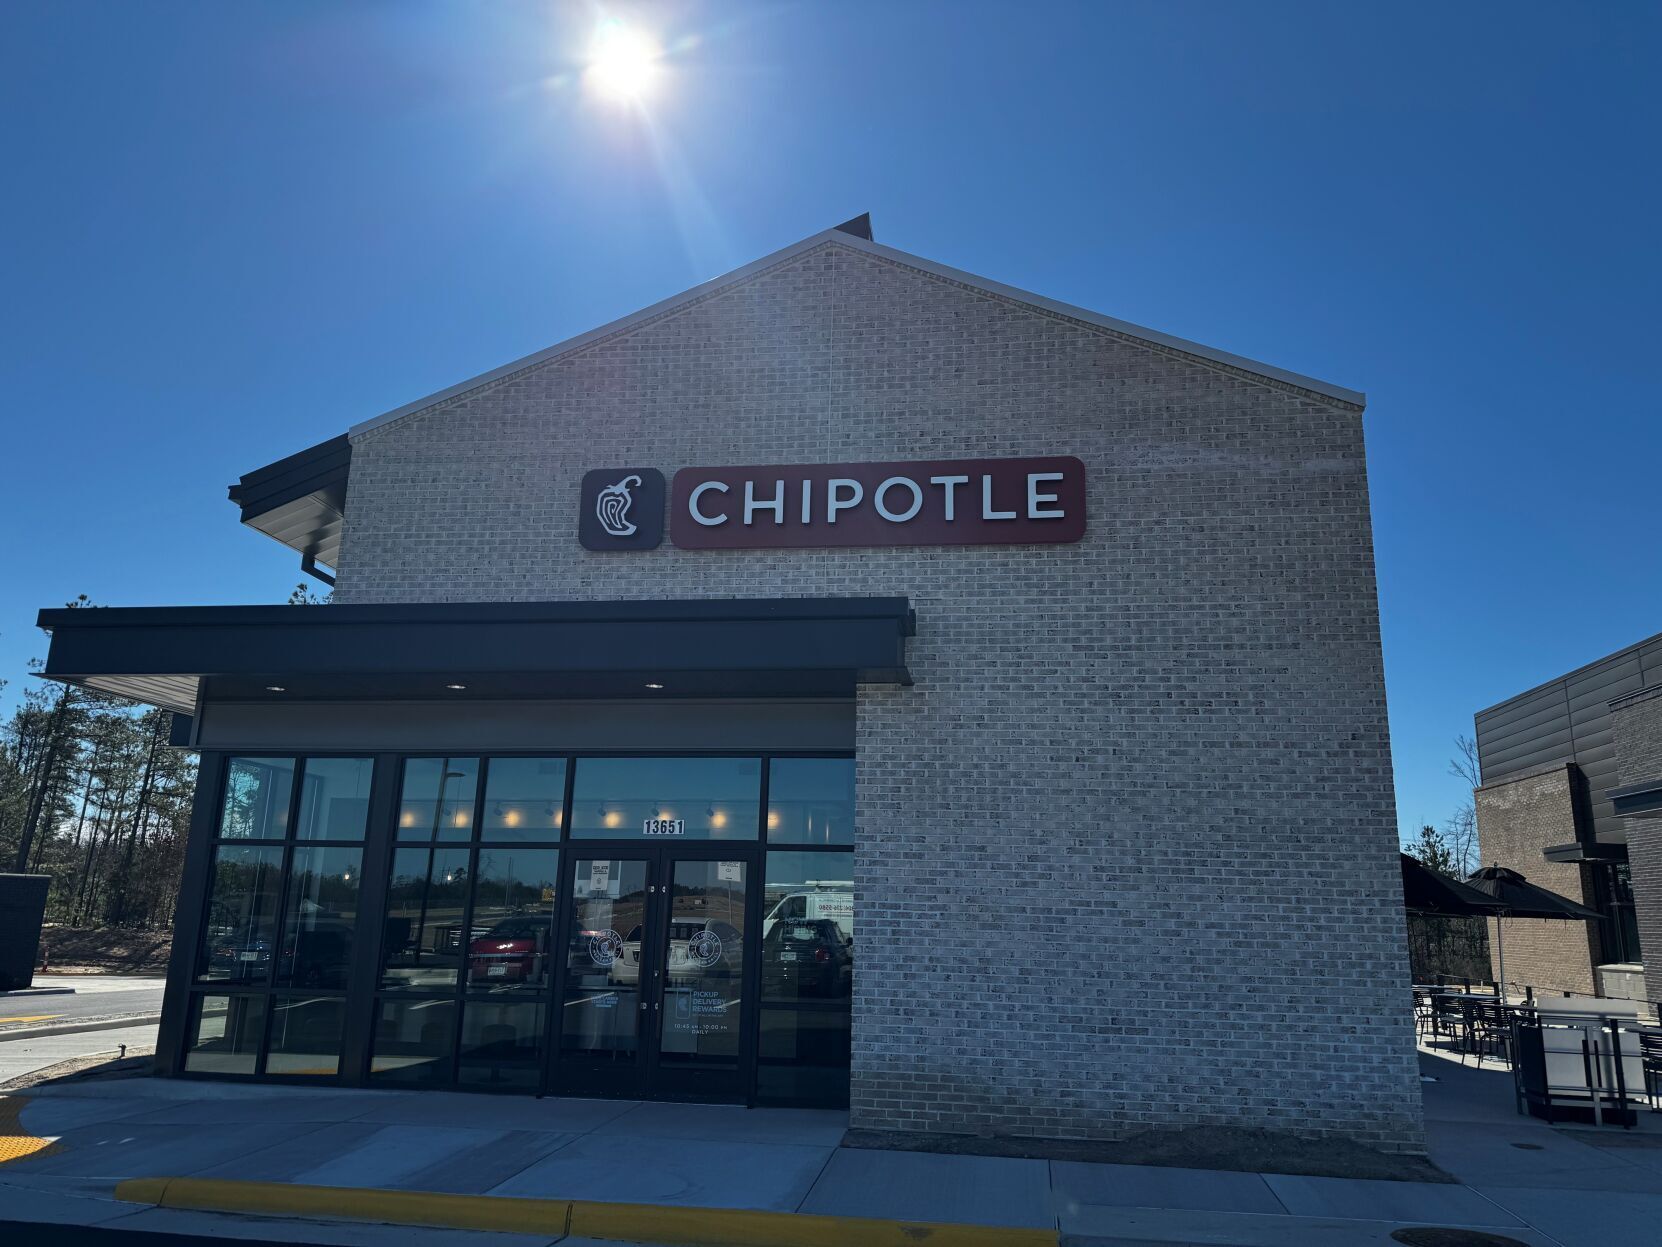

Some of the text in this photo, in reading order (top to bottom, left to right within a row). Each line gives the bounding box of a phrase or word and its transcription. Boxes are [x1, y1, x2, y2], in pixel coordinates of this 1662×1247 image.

[688, 472, 1065, 526] CHIPOTLE
[645, 819, 683, 834] 13651
[692, 1005, 728, 1013] REWARDS
